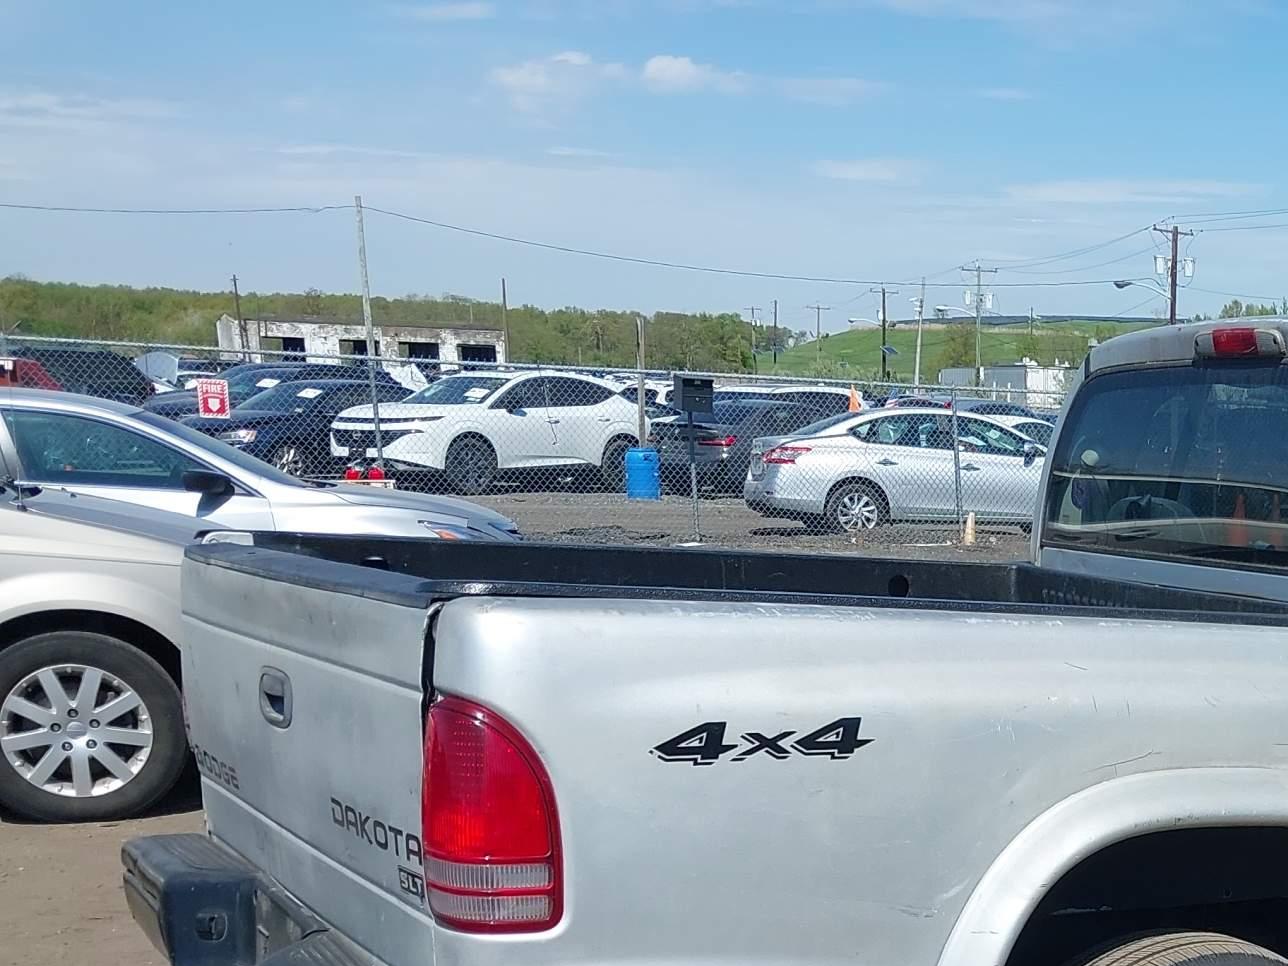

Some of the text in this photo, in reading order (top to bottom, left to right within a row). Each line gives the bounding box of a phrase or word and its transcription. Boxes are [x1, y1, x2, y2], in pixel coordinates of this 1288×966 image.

[202, 383, 224, 394] FIRE
[648, 717, 876, 766] 4x4
[194, 743, 240, 790] DODGE
[331, 796, 423, 866] DAKOTA
[400, 871, 424, 895] SLT
